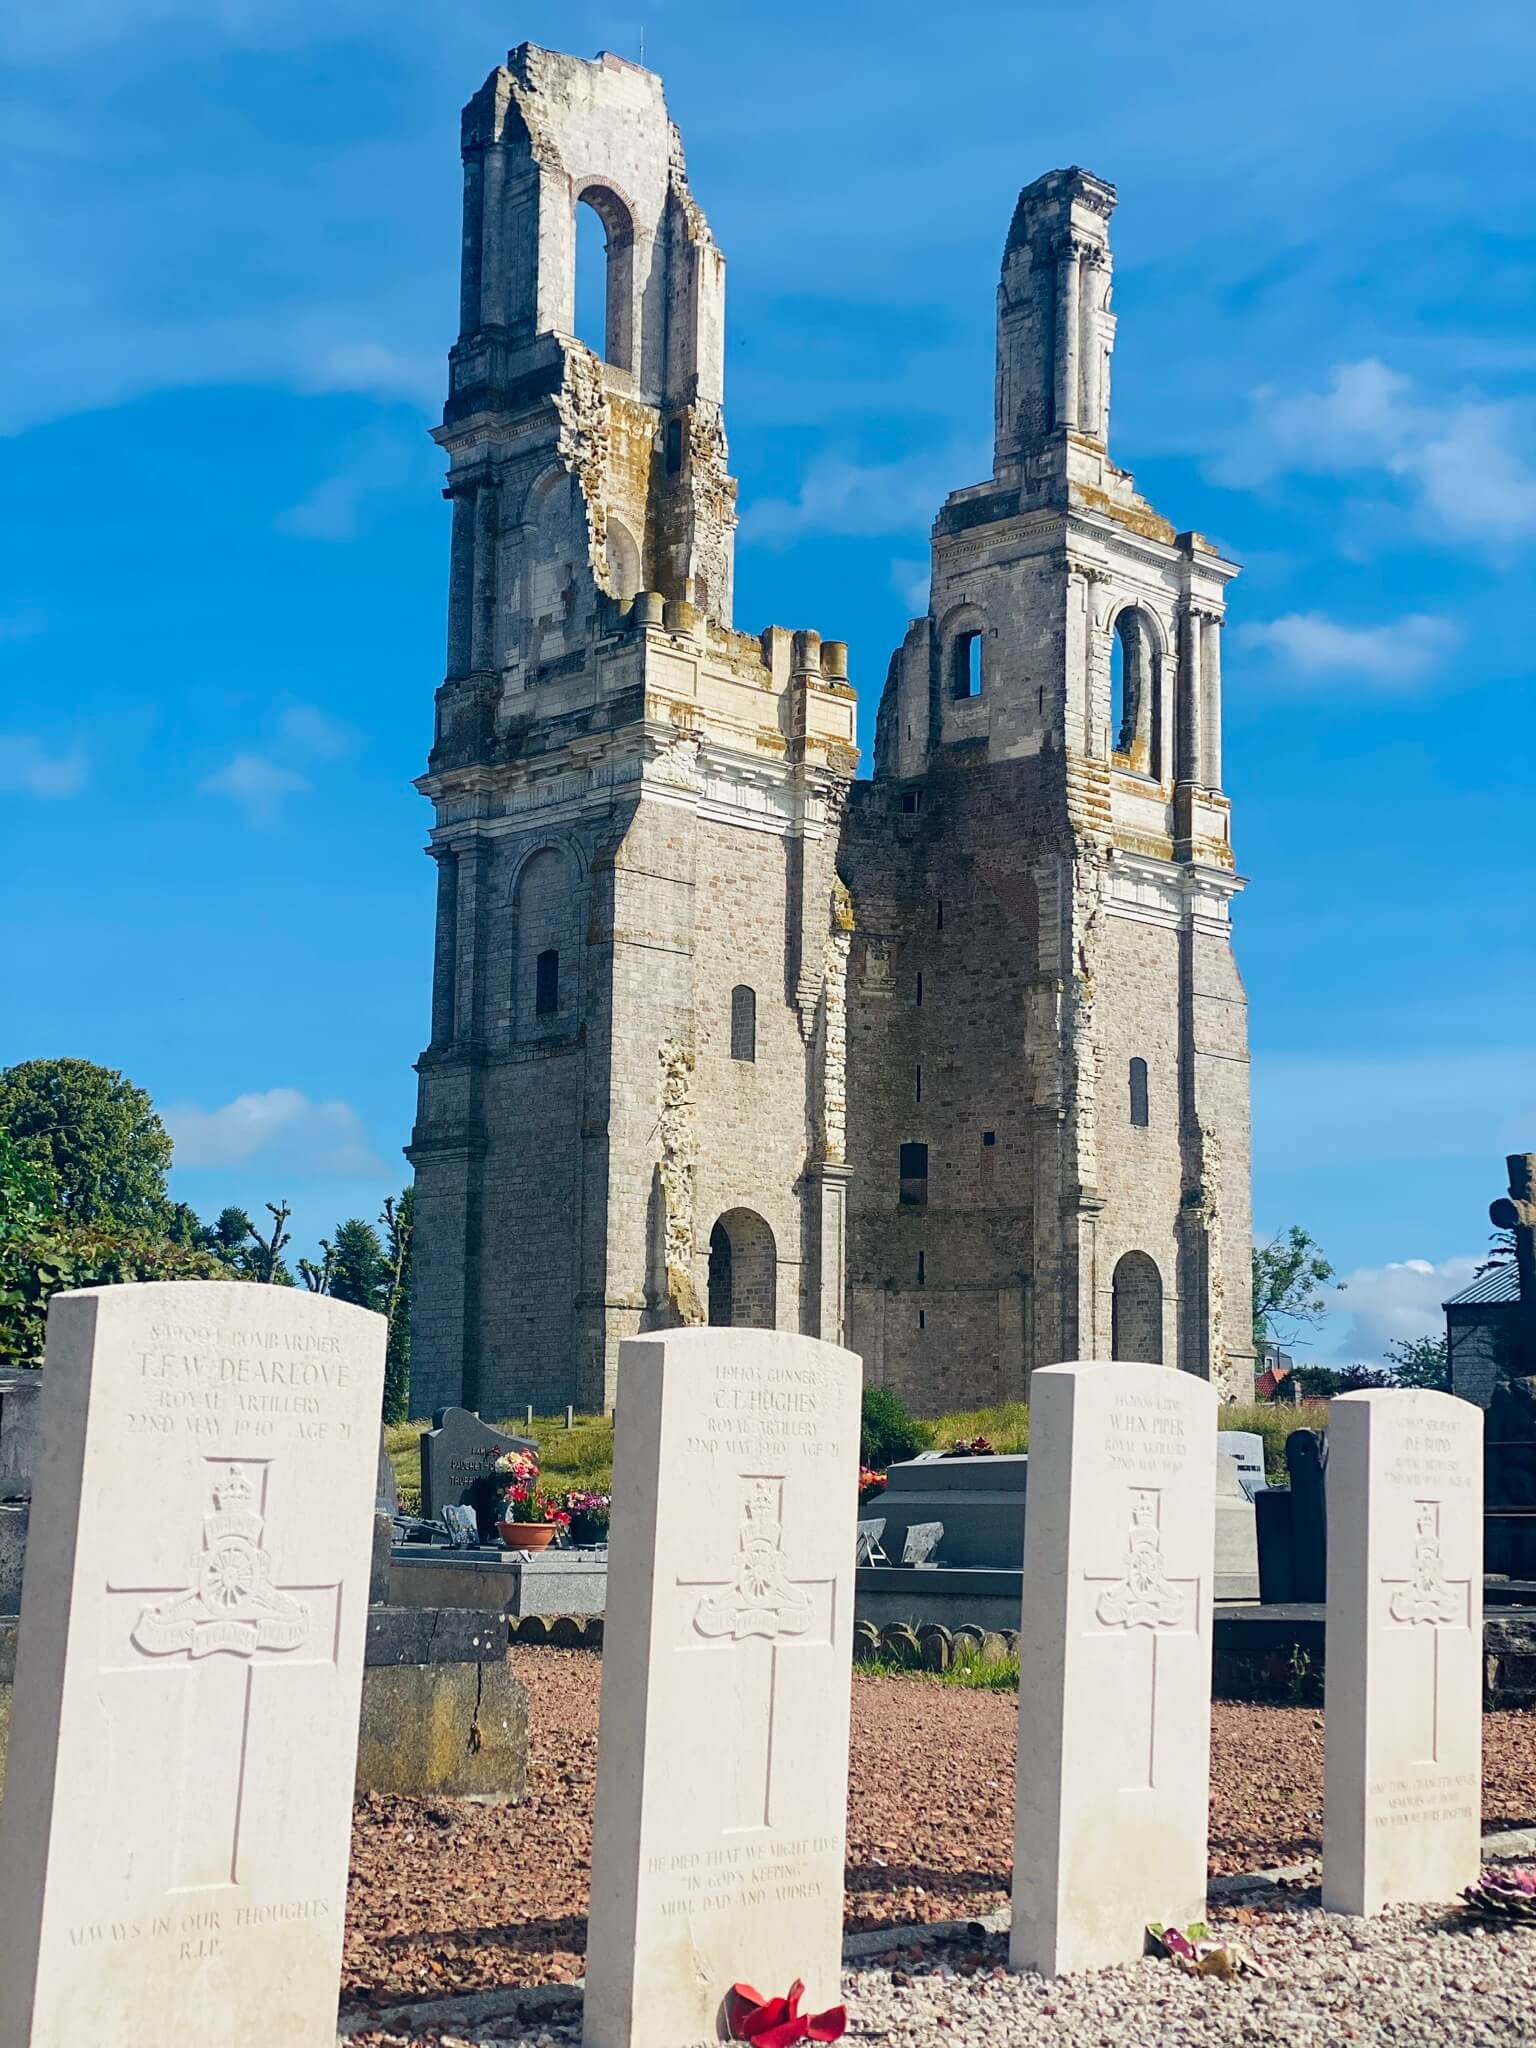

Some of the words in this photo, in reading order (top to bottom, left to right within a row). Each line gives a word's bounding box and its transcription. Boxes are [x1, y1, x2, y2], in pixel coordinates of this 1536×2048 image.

[231, 1330, 341, 1354] BOMBARDIER
[220, 1356, 351, 1388] DEARLOVE
[767, 1368, 817, 1385] GUNNER
[158, 1390, 223, 1411] ROYAL
[238, 1394, 321, 1415] ARTILLERY
[750, 1390, 817, 1413] HUGHES
[127, 1413, 175, 1434] 22ND
[184, 1416, 221, 1435] MAY
[234, 1419, 274, 1437] 1940
[296, 1421, 329, 1440] AGE
[707, 1417, 750, 1434] ROYAL
[759, 1420, 818, 1437] ARTILLERY
[648, 1856, 666, 1873] HE
[671, 1853, 700, 1872] DIED
[705, 1848, 741, 1866] THAT
[769, 1840, 809, 1858] MIGHT
[703, 1894, 731, 1912] DAD
[739, 1888, 767, 1907] AND
[774, 1881, 824, 1902] AUDREY
[67, 1920, 142, 1946] ALWAYS
[151, 1917, 172, 1937] IN
[181, 1911, 221, 1932] OUR
[233, 1899, 330, 1927] THOUGHTS
[179, 1938, 224, 1961] R.I.P.
